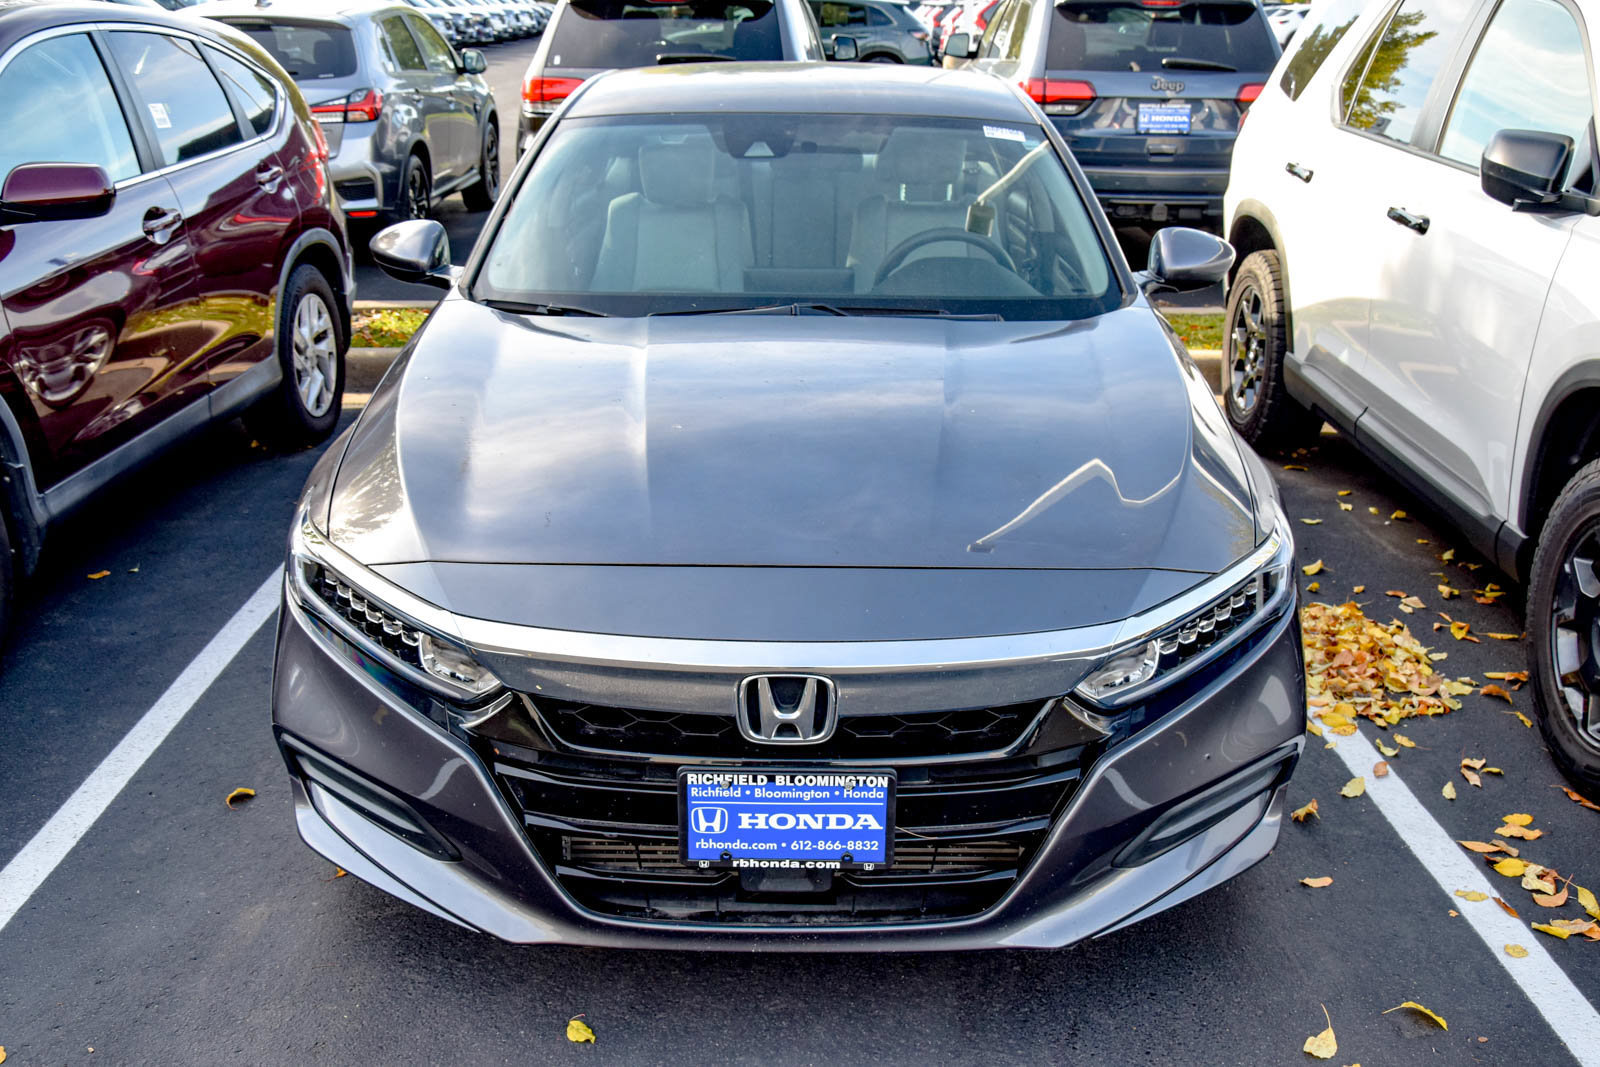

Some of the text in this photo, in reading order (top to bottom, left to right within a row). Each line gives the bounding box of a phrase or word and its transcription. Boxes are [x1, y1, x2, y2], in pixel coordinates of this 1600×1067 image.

[1151, 78, 1185, 93] Jeep
[687, 773, 888, 788] RICHFIELD BLOOMINGTON
[691, 786, 884, 800] Richfield Bloomington Honda
[738, 813, 883, 830] HONDA
[696, 838, 879, 850] rbhonda.com 612-866-8832
[732, 859, 840, 869] rbhonda.com
